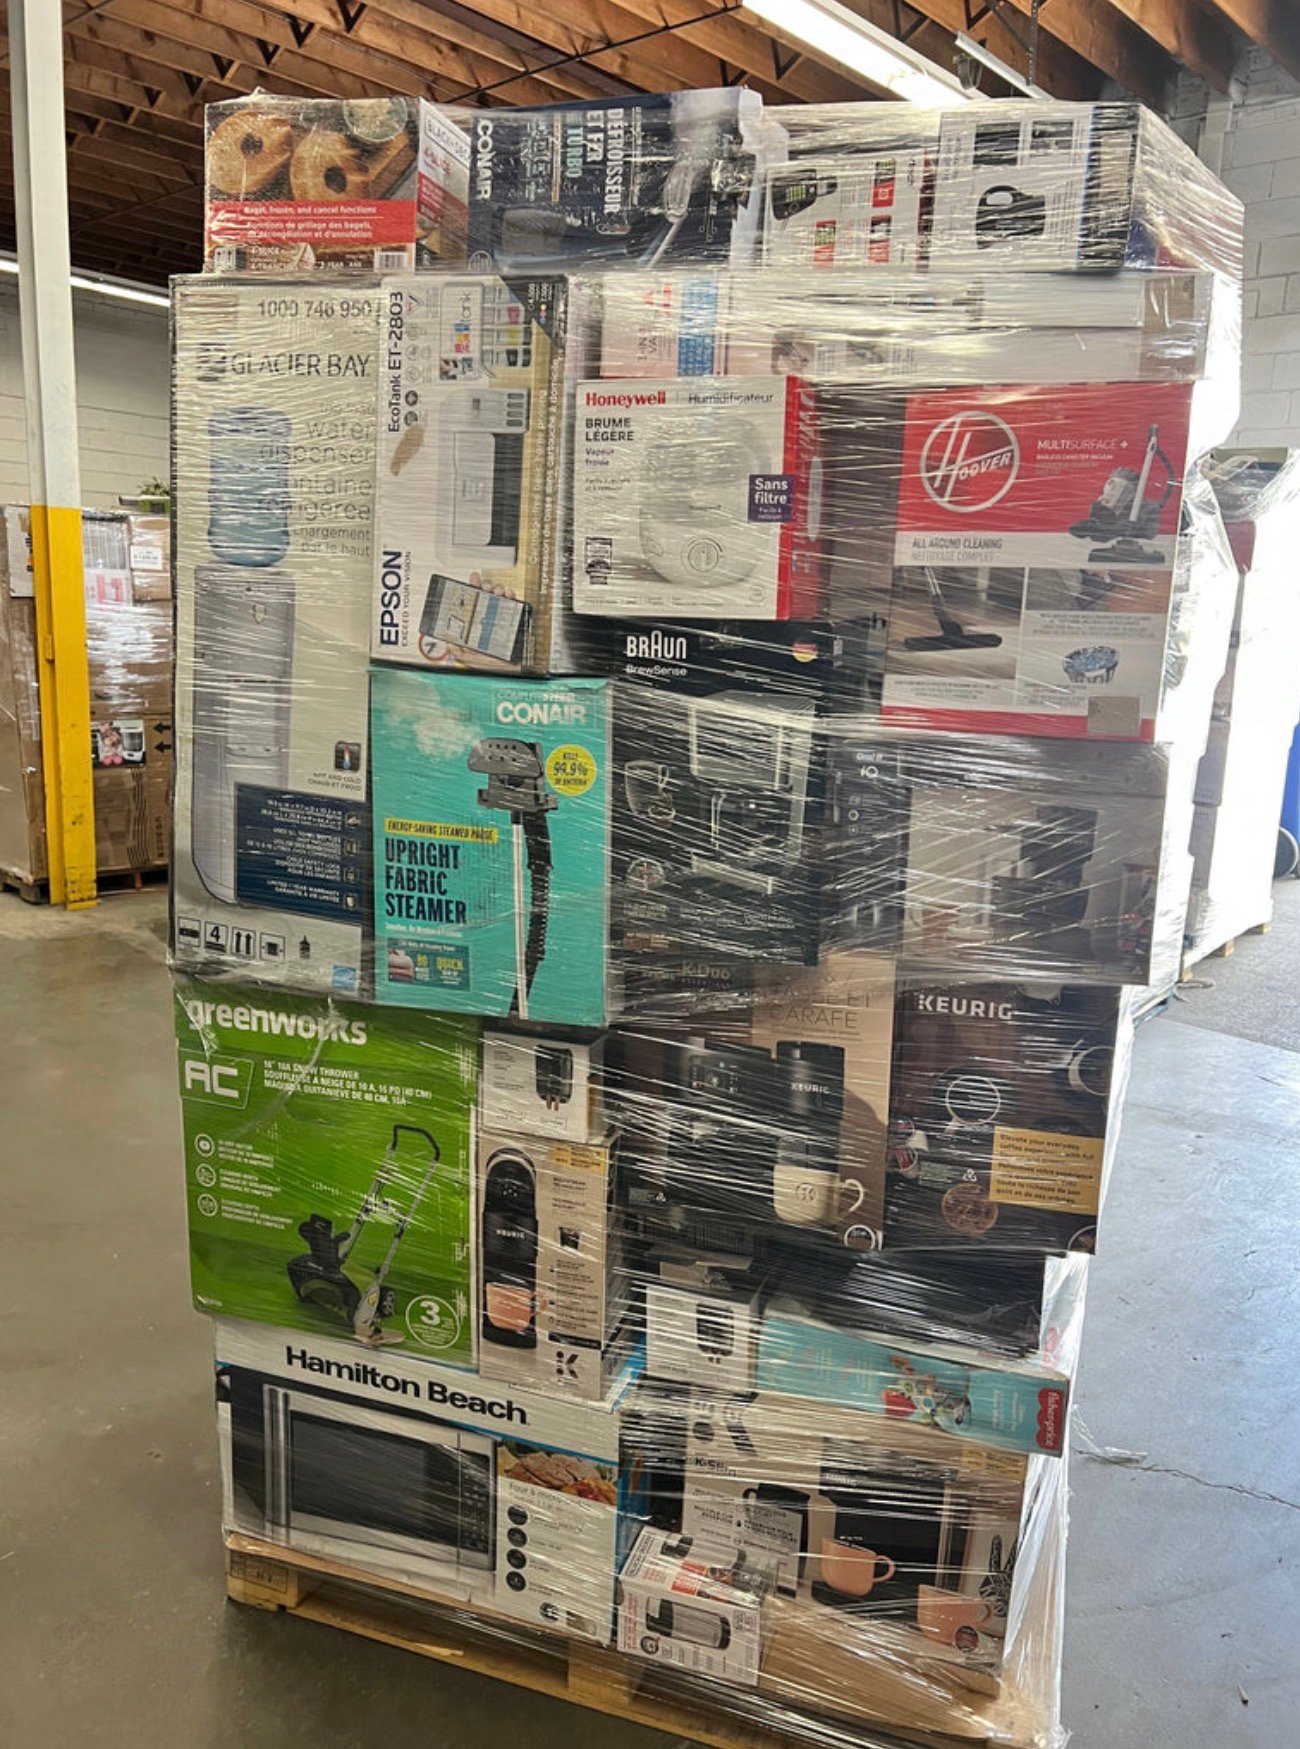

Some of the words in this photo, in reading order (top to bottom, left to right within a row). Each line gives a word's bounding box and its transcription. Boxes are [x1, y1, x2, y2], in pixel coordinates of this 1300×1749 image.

[587, 110, 604, 128] ET
[567, 127, 583, 178] TURBO
[587, 132, 604, 163] FER
[476, 119, 493, 200] CONAIR
[296, 206, 312, 214] and
[340, 206, 377, 215] functions
[286, 222, 296, 230] de
[339, 301, 372, 318] 950
[388, 291, 403, 371] ET-2803
[231, 353, 321, 376] GLACIER
[327, 355, 370, 377] BAY
[388, 374, 401, 433] EcoTank
[586, 390, 666, 409] Honeywell
[688, 391, 774, 405] Humidificateur
[585, 417, 632, 429] BRUME
[1037, 439, 1118, 450] MULTISURFACE
[754, 477, 788, 491] Sans
[754, 491, 788, 505] filtre
[912, 537, 926, 549] ALL
[928, 537, 961, 549] AROUND
[962, 537, 1003, 550] CLEANING
[380, 550, 403, 646] EPSON
[626, 631, 687, 660] BRAUN
[626, 664, 688, 677] BrewSense
[496, 701, 587, 724] CONAIR
[387, 819, 438, 836] ENERGY-SAVING
[384, 837, 460, 870] UPRIGHT
[384, 864, 448, 897] FABRIC
[385, 892, 467, 925] STEAMER
[209, 925, 220, 942] 4
[769, 1004, 859, 1030] CARAFE
[918, 993, 1014, 1021] KEURIG
[187, 999, 368, 1046] greenworks
[184, 1059, 239, 1099] AC
[319, 1067, 360, 1080] THROWER
[320, 1077, 345, 1089] NEIGE
[345, 1080, 358, 1090] DE
[790, 1082, 831, 1095] KEURIG
[495, 1228, 526, 1240] KEURIG
[419, 1300, 441, 1326] 3
[285, 1345, 421, 1400] Hamilton
[427, 1379, 529, 1427] Beach
